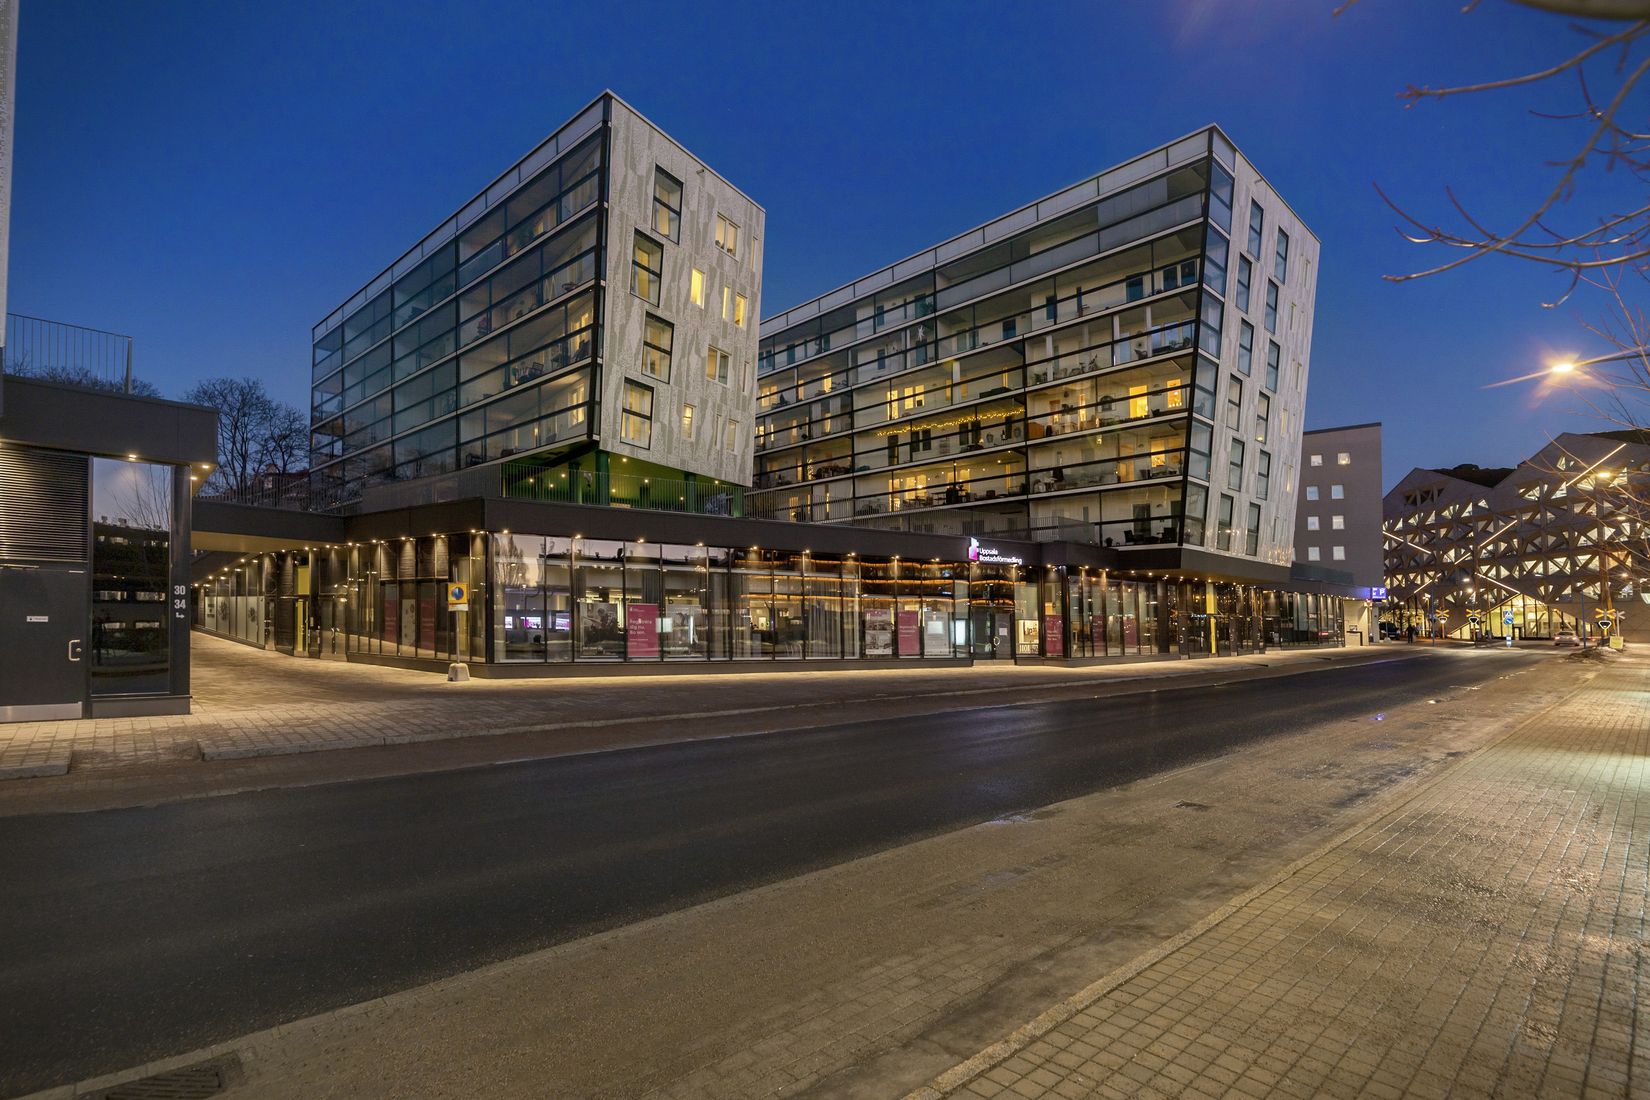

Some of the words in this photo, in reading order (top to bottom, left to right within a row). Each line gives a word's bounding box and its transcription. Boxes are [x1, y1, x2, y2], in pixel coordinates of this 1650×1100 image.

[980, 555, 1022, 565] Bostadsförmedling
[174, 585, 186, 595] 30
[174, 599, 186, 609] 34
